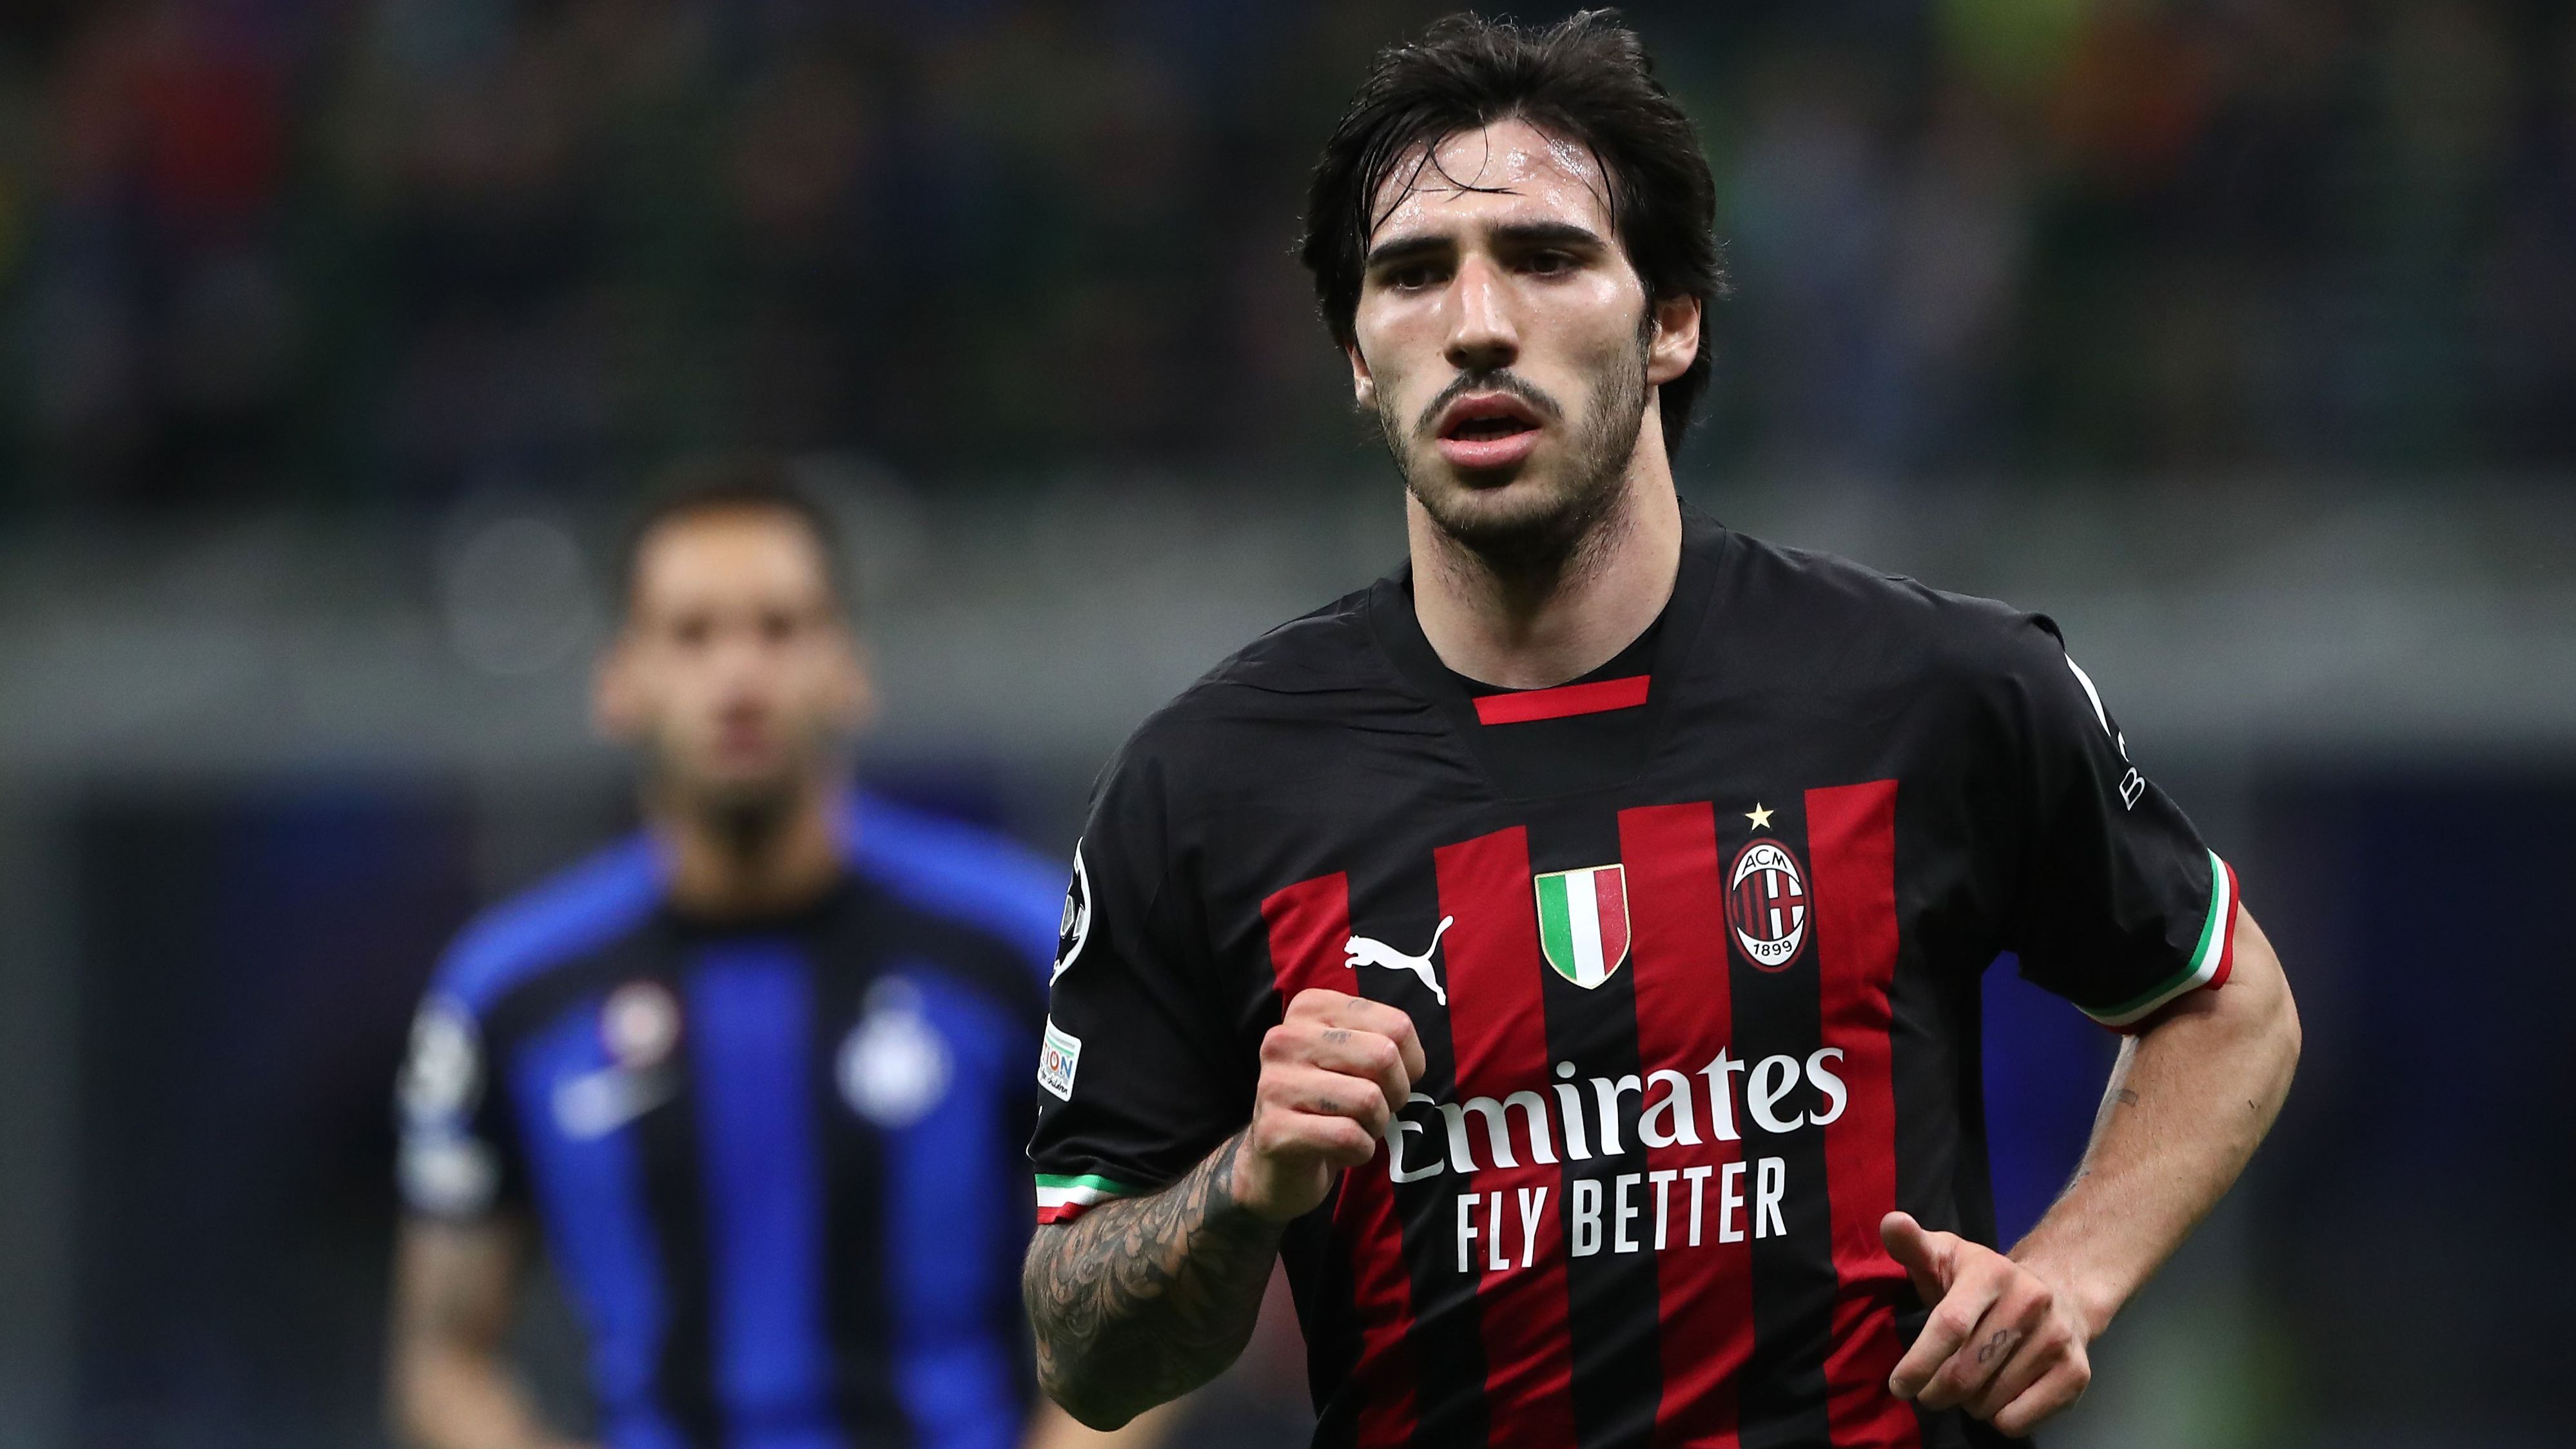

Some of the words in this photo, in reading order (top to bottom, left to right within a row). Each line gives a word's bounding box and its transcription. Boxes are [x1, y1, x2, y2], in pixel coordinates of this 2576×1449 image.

[1741, 848, 1788, 876] ACM
[1752, 940, 1793, 957] 1899
[1385, 1045, 1848, 1183] Emirates
[1457, 1186, 1548, 1273] FLY
[1572, 1156, 1787, 1258] BETTER
